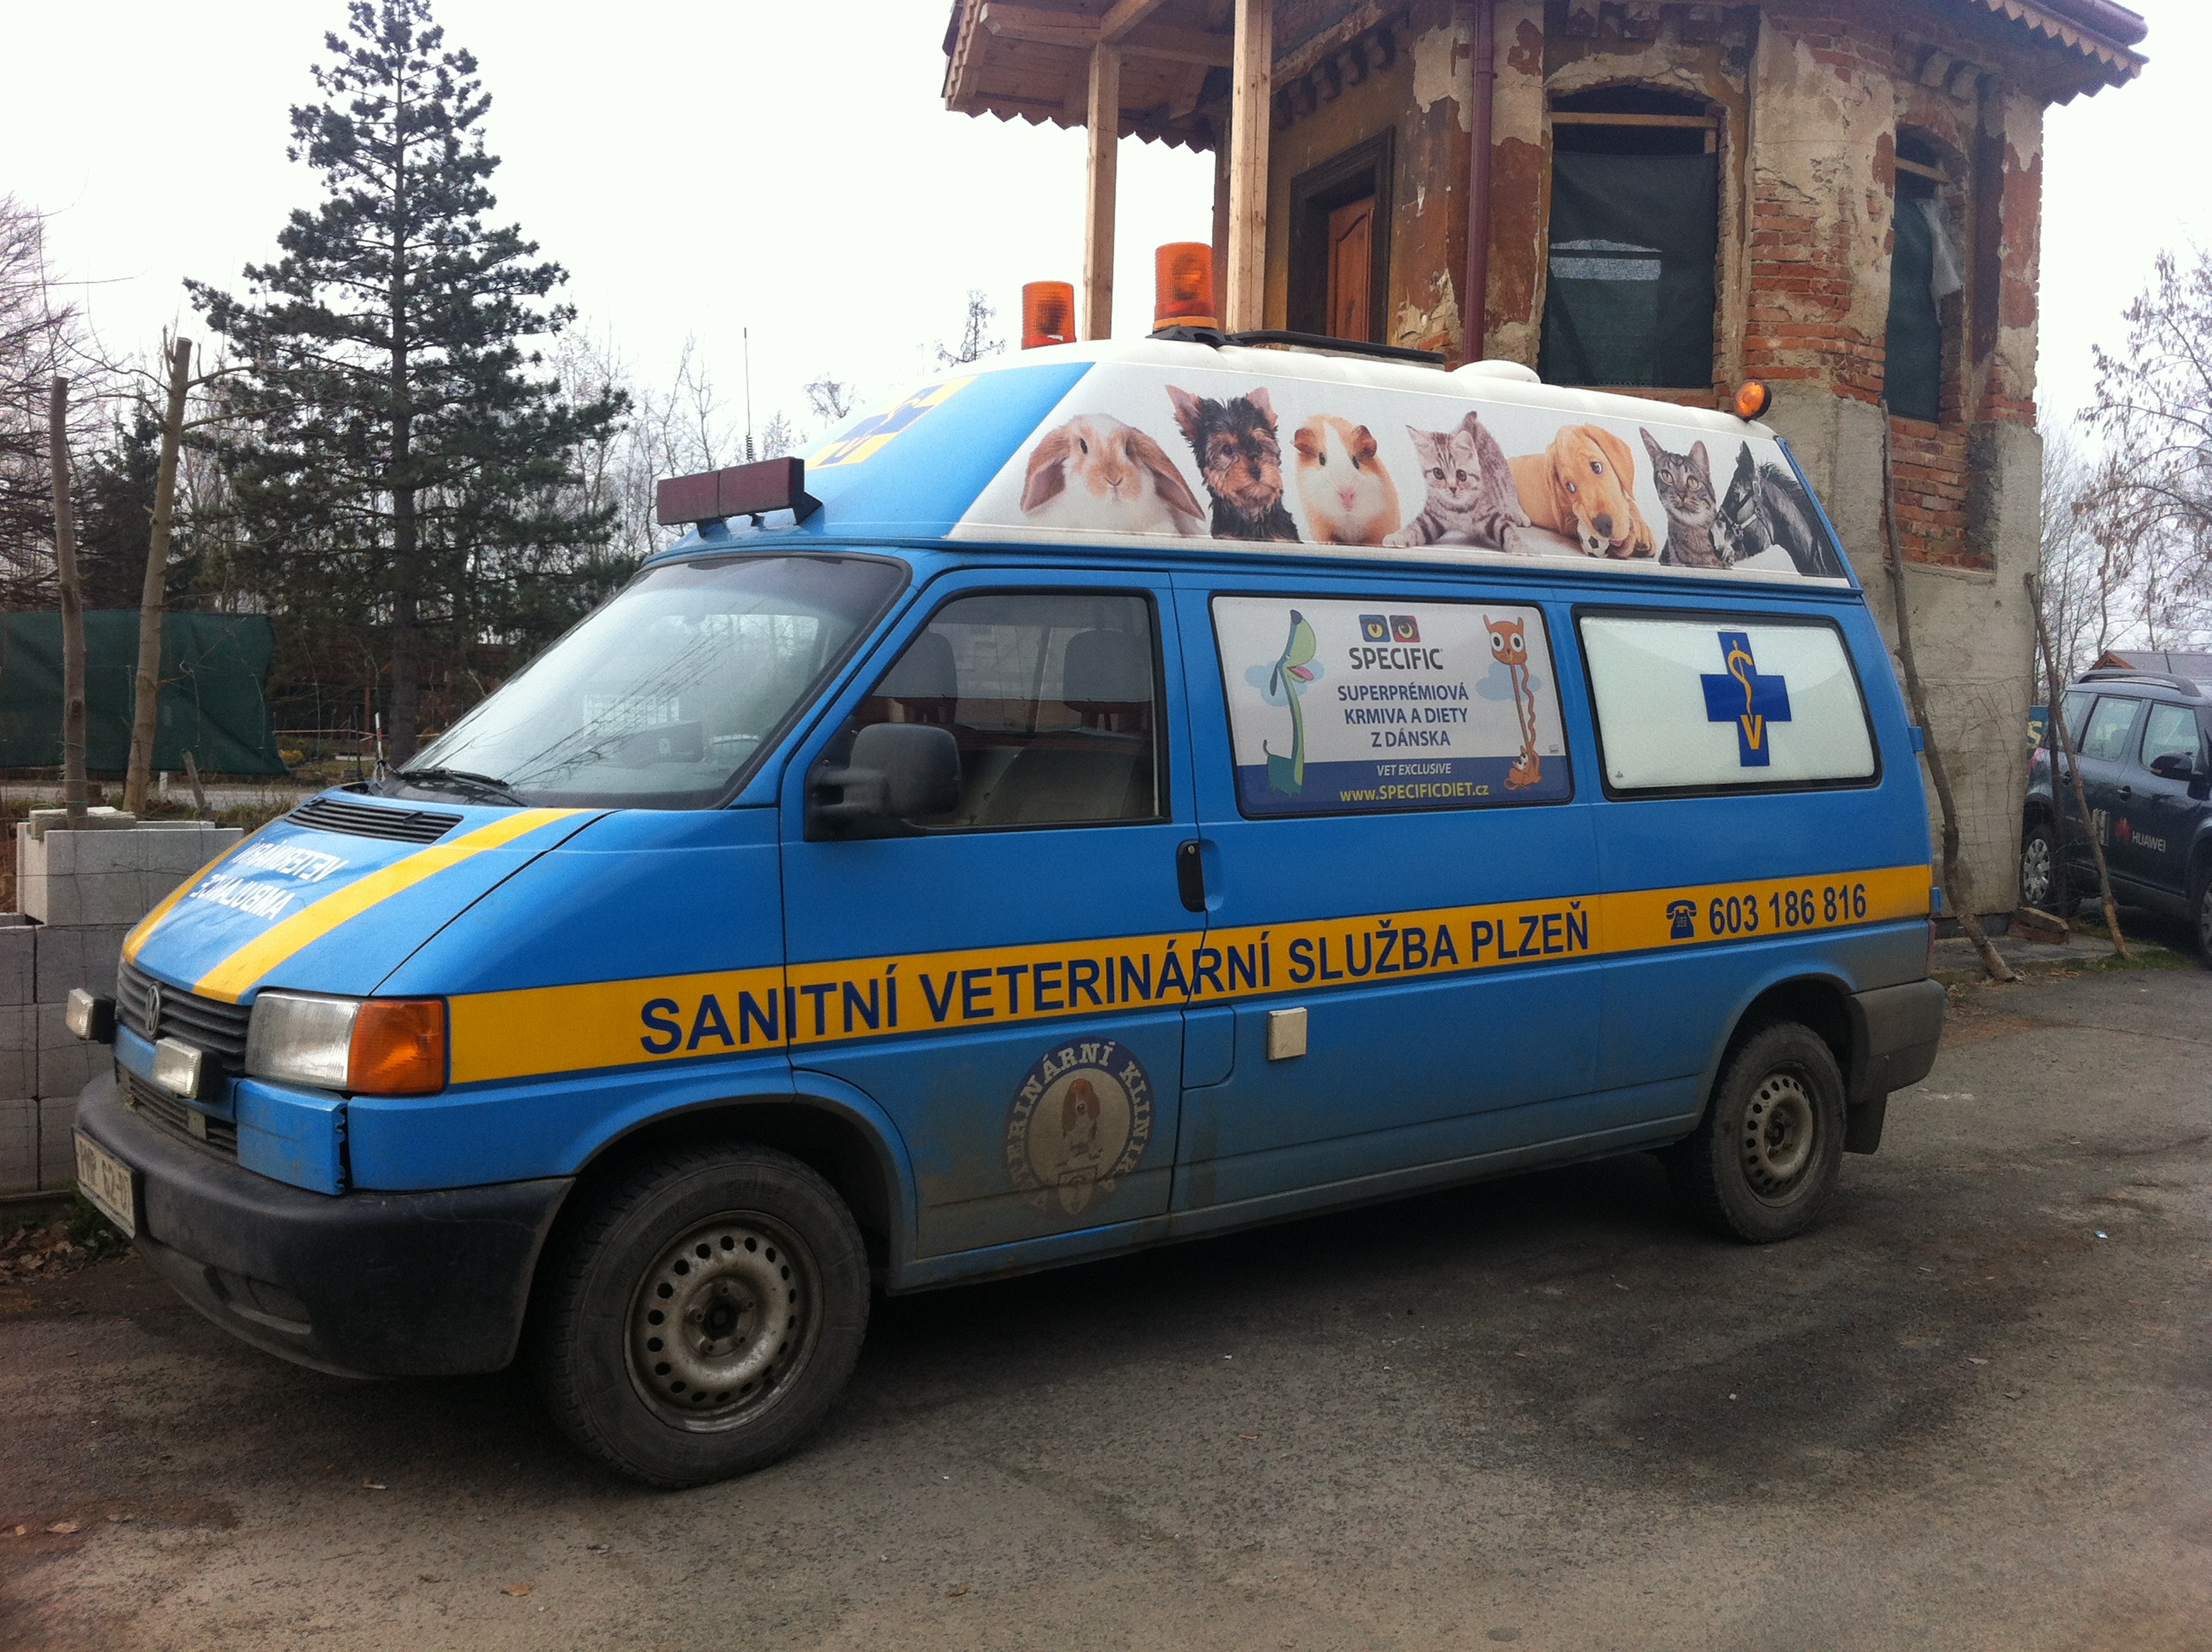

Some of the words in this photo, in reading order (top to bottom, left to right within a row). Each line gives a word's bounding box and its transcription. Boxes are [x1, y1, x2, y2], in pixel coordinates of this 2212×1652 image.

[1348, 647, 1444, 671] SPECIFIC
[1337, 682, 1469, 701] SUPERPRÉMIOVÁ
[1344, 707, 1407, 725] KRMIVA
[1411, 707, 1423, 724] A
[1424, 707, 1468, 724] DIETY
[1371, 731, 1383, 747] Z
[1384, 726, 1451, 747] DÁNSKA
[1377, 764, 1398, 777] VET
[1399, 762, 1452, 777] EXCLUSIVE
[1339, 782, 1489, 803] www.SPECIFICDIET.cz
[2132, 829, 2166, 852] HUAWEI
[1708, 893, 1759, 936] 603
[1768, 888, 1815, 929] 186
[1823, 882, 1867, 922] 816
[639, 963, 899, 1056] SANITNÍ
[918, 930, 1271, 1023] VETERINÁRNÍ
[1288, 919, 1459, 985] SLUŽBA
[1470, 900, 1590, 964] PLZEŇ
